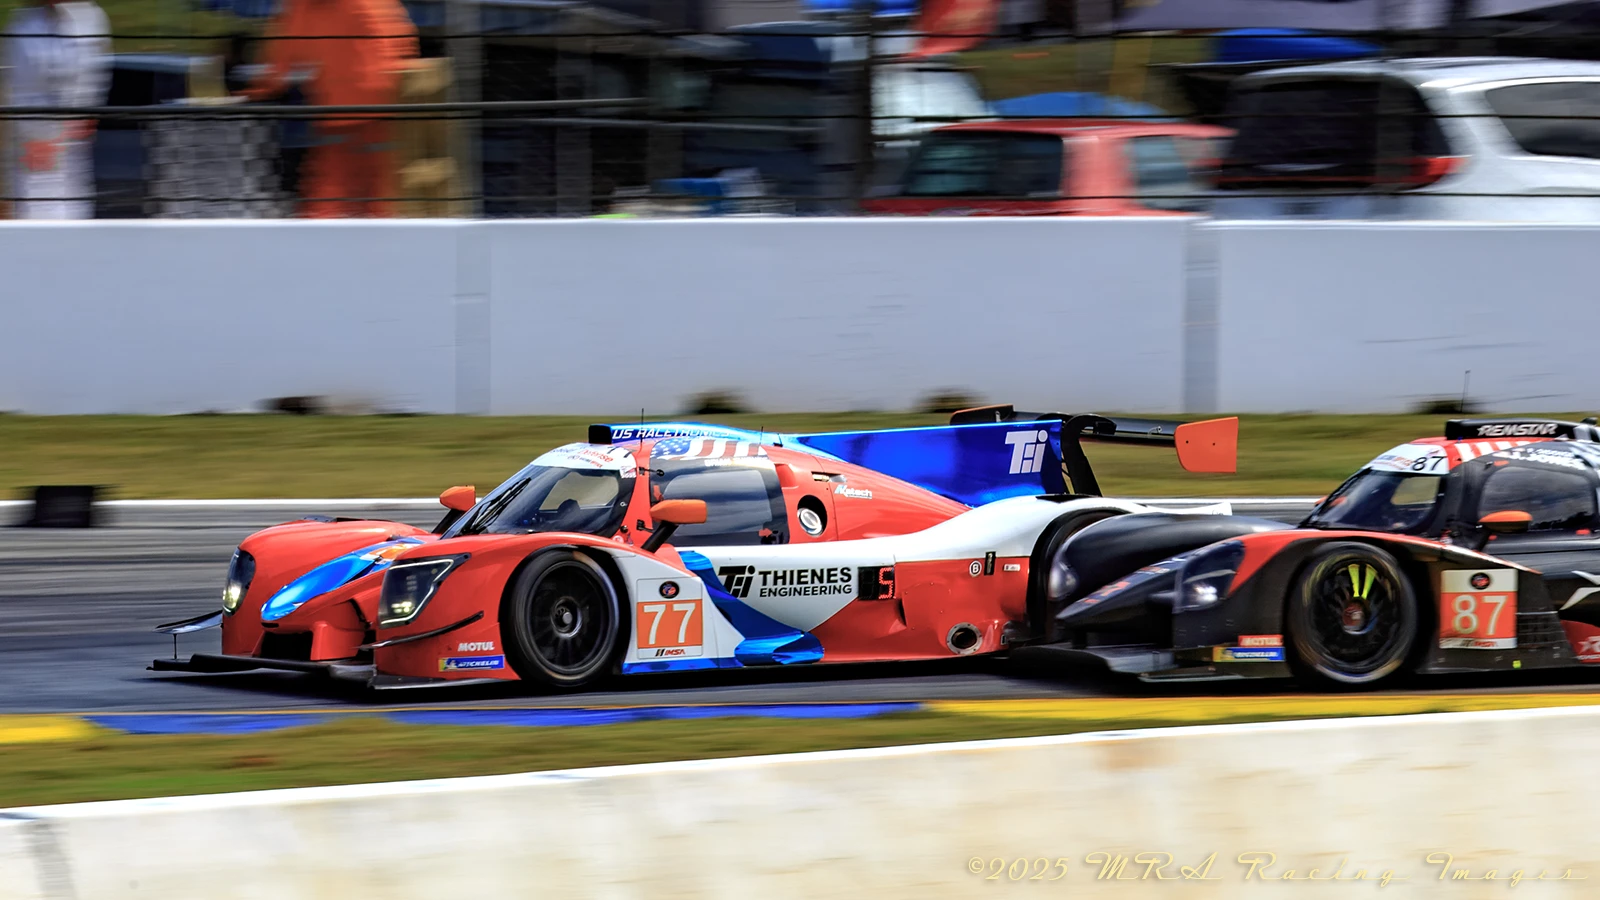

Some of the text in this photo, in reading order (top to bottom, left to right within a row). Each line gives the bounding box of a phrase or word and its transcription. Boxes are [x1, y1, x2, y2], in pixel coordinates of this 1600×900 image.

[612, 429, 634, 440] US
[1477, 423, 1558, 437] REMSTAR
[1412, 456, 1448, 471] 87
[758, 567, 852, 586] THIENES
[759, 584, 852, 598] ENGINEERING
[1453, 594, 1508, 636] 87
[643, 603, 696, 645] 77
[457, 641, 495, 652] MOTUL
